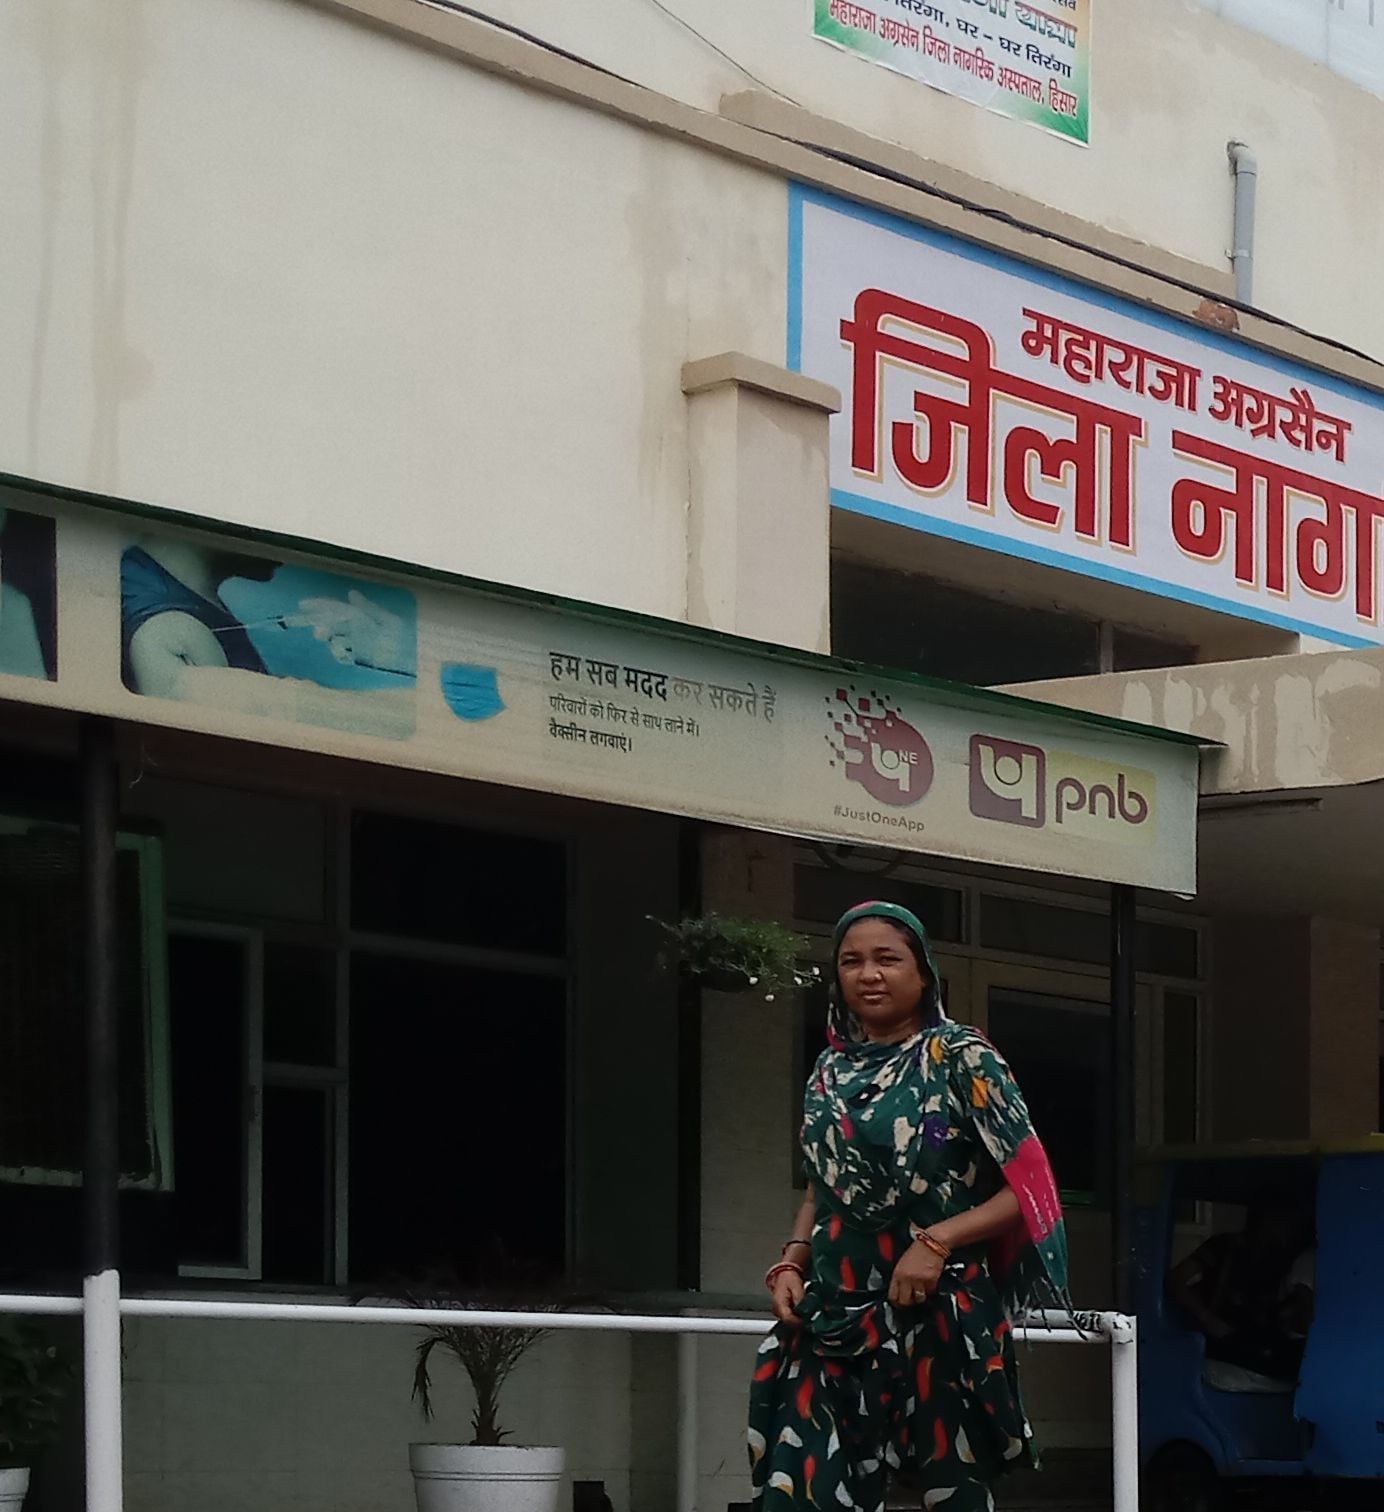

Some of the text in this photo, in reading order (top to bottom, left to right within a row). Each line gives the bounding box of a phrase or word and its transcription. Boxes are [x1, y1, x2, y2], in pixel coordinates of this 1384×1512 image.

[922, 24, 951, 64] जिला
[953, 46, 994, 82] नागरिक
[1048, 78, 1077, 116] हिसार
[956, 18, 978, 38] घर
[999, 35, 1021, 56] घर
[1026, 43, 1072, 78] तिरंगा
[1022, 307, 1352, 462] महाराजा अग्रसैन
[840, 288, 1142, 548] जिला
[550, 652, 777, 723] हम सब मदद कर सकते हैं
[550, 692, 586, 716] परिवारों
[589, 700, 603, 720] को
[606, 701, 627, 723] फिर
[630, 706, 639, 728] से
[664, 715, 684, 735] लाने
[549, 717, 586, 744] वैक्सीन
[833, 805, 925, 833] #JustOneApp
[1055, 773, 1149, 824] pnb
